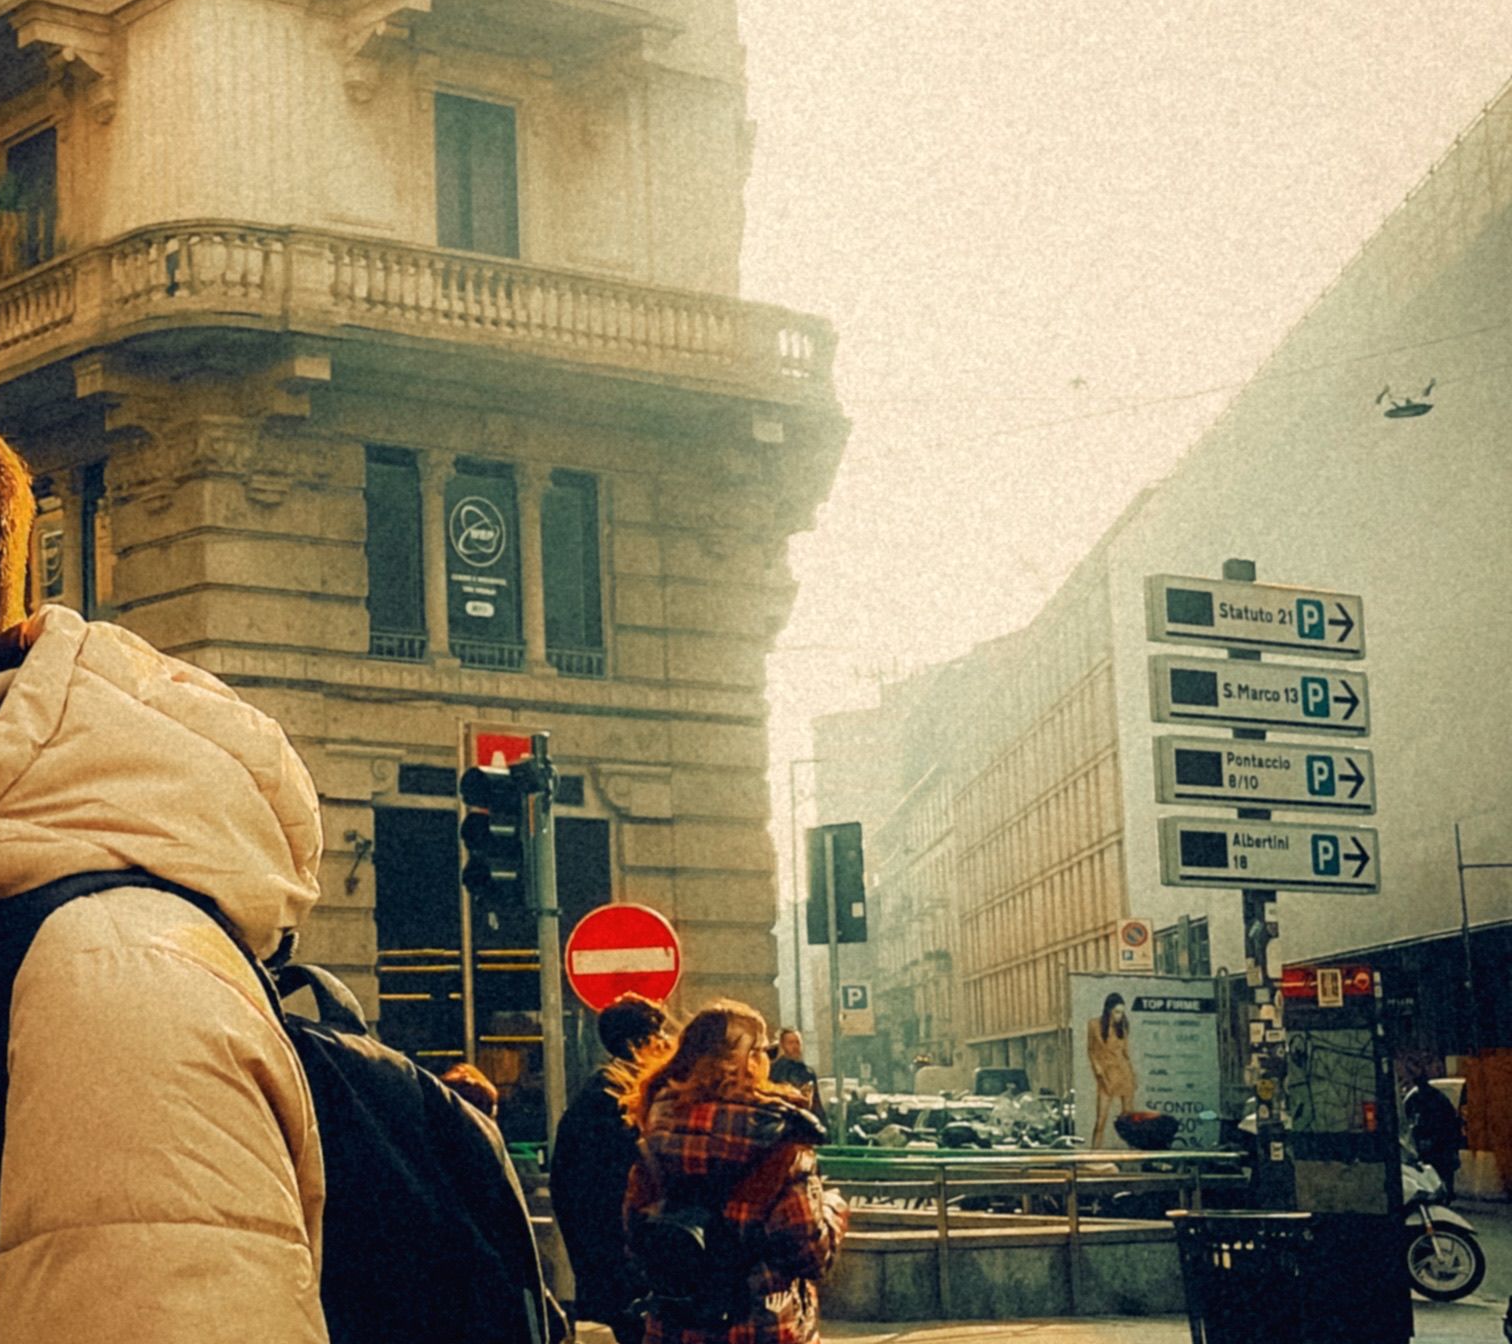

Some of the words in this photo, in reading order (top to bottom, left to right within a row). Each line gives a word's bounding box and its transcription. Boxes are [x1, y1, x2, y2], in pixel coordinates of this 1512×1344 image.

[1219, 602, 1274, 624] Statuto
[1278, 608, 1293, 625] 21
[1284, 687, 1298, 704] 13
[1227, 752, 1291, 770] Pontaccio
[1229, 774, 1259, 790] 8/10
[1233, 832, 1290, 850] Albertini
[1233, 855, 1248, 869] 18
[848, 987, 863, 1007] P
[1142, 999, 1164, 1010] TOP
[1166, 999, 1201, 1011] FIRME
